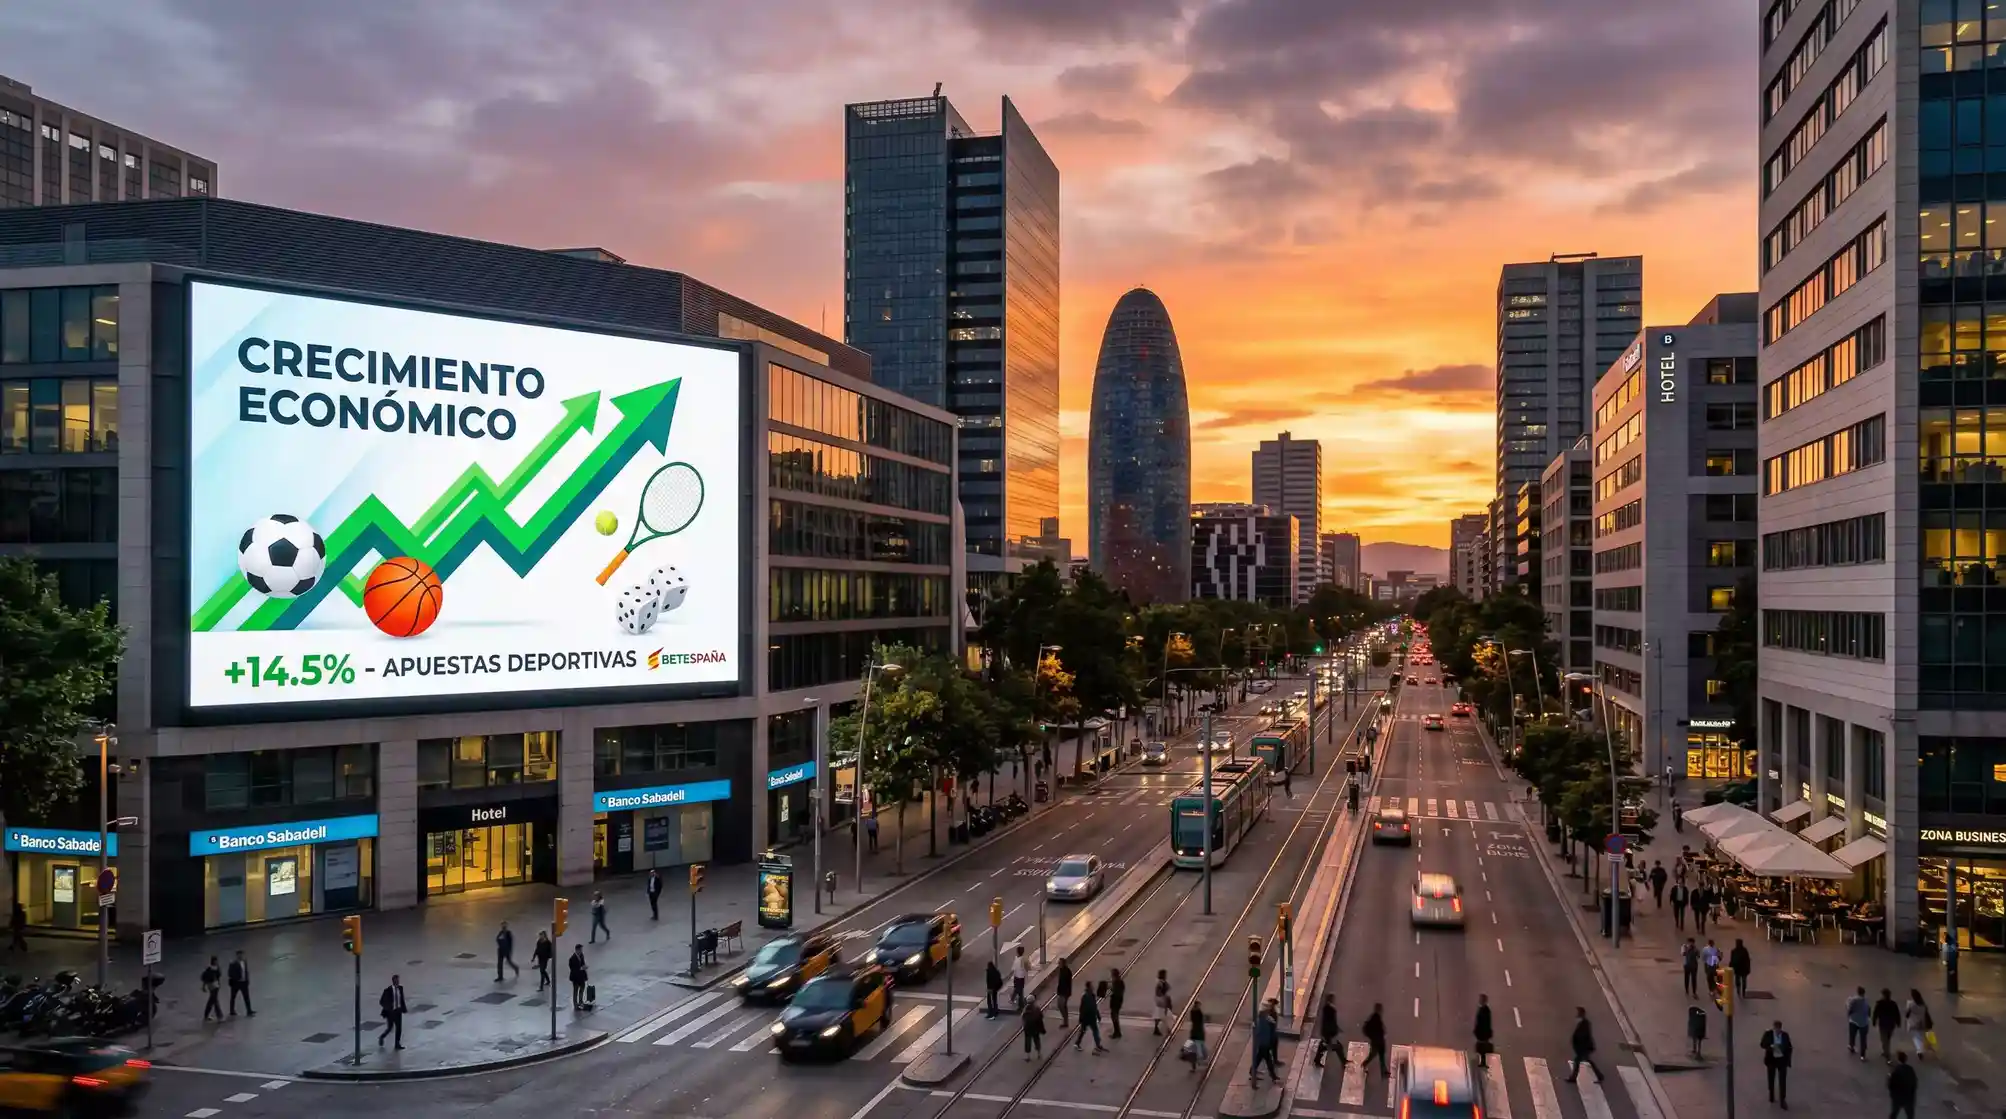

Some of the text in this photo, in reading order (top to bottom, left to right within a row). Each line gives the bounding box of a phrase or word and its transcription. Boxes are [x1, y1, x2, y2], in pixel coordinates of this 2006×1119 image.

[1664, 335, 1673, 344] B
[238, 337, 545, 399] CRECIMIENTO
[1660, 352, 1675, 402] HOTEL
[239, 386, 517, 441] ECONÓMICO
[661, 650, 727, 665] BETESPAÑA
[224, 653, 356, 688] +14.5%
[382, 654, 501, 677] APUESTAS
[508, 650, 637, 673] DEPORTIVAS
[608, 789, 685, 808] Banco Sabadell
[471, 806, 506, 821] Hotel
[20, 834, 56, 849] Banco
[219, 834, 265, 849] Banco
[266, 825, 327, 844] Sabadell
[1920, 829, 2006, 843] ZONA BUSINES
